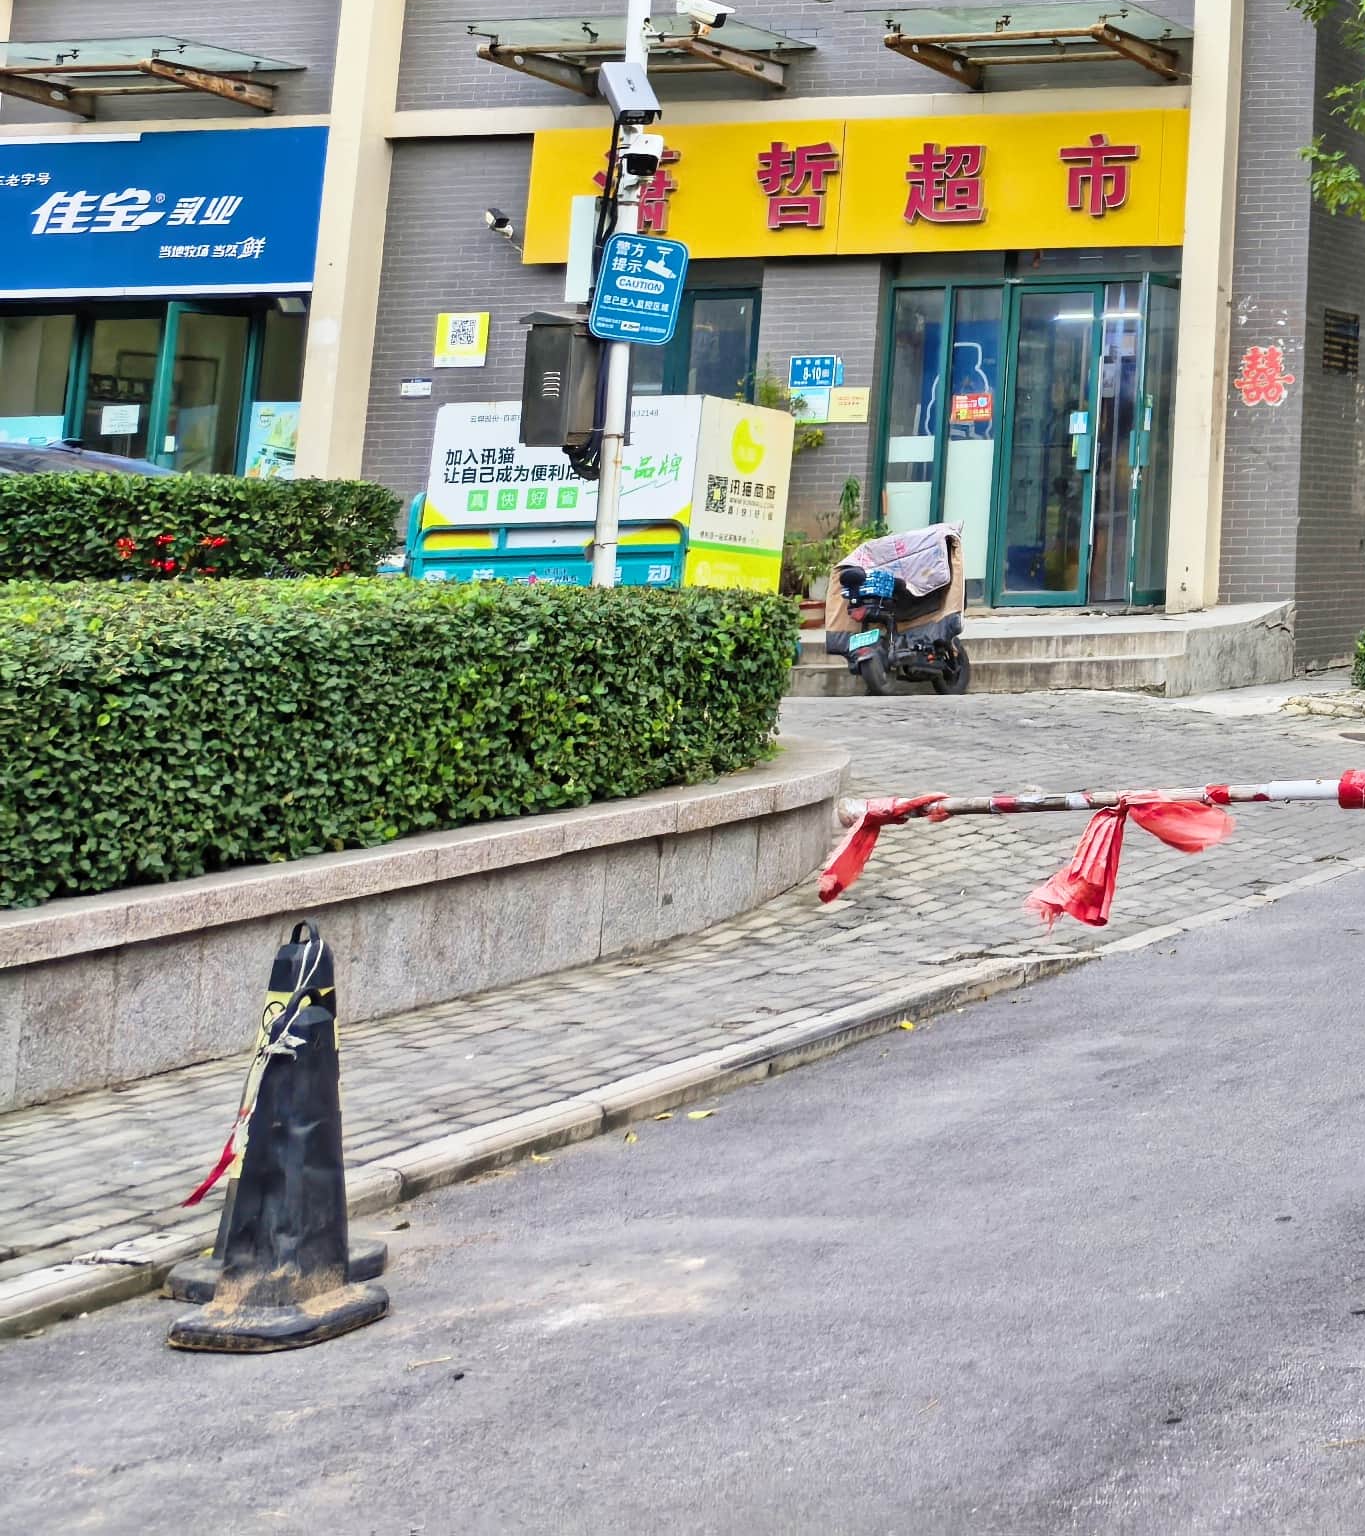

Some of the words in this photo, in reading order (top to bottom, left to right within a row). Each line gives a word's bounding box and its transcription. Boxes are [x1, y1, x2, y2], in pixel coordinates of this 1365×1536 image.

[31, 187, 166, 235] 佳宝
[166, 195, 244, 226] 乳业
[615, 240, 646, 258] 警方
[611, 256, 643, 273] 提示
[618, 277, 662, 292] CAUTION
[445, 447, 515, 465] 加入讯猫
